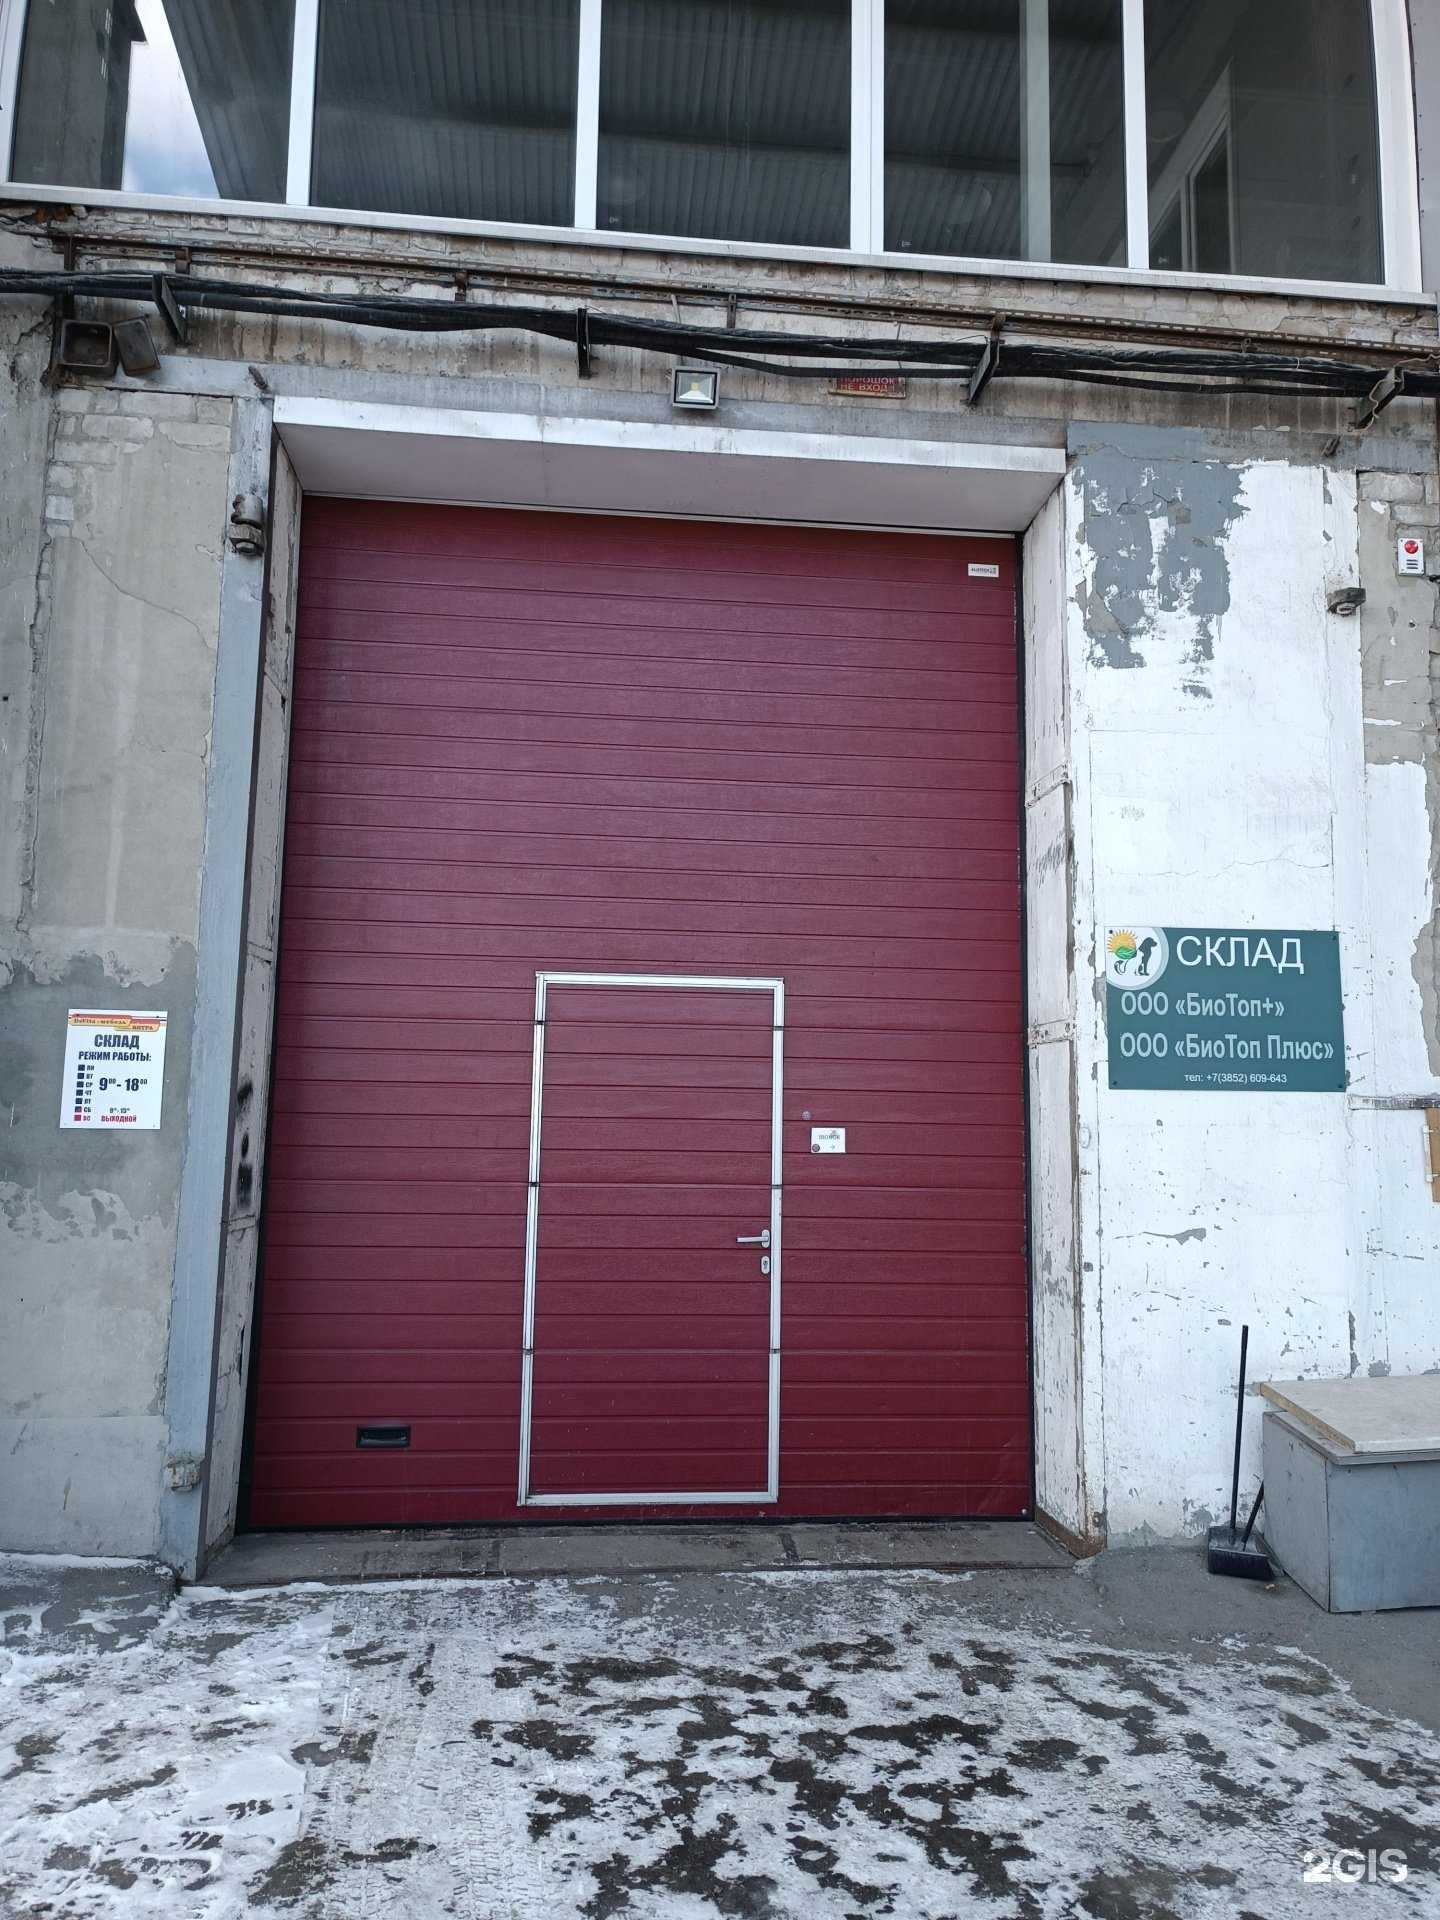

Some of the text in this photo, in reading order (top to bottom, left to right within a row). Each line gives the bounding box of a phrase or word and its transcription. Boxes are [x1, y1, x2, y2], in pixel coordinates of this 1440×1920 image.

[1176, 935, 1305, 975] СКЛАД
[1120, 991, 1285, 1017] ООО «БиоТоп+»
[94, 1034, 140, 1050] СКЛАД
[1120, 1032, 1334, 1060] ООО «БиоТоп Плюс»
[78, 1051, 152, 1062] РЕЖИМ РАБОТЫ:
[1184, 1073, 1287, 1085] тел: +7(3852) 609-643
[101, 1115, 137, 1123] ВЫХОДНОЙ
